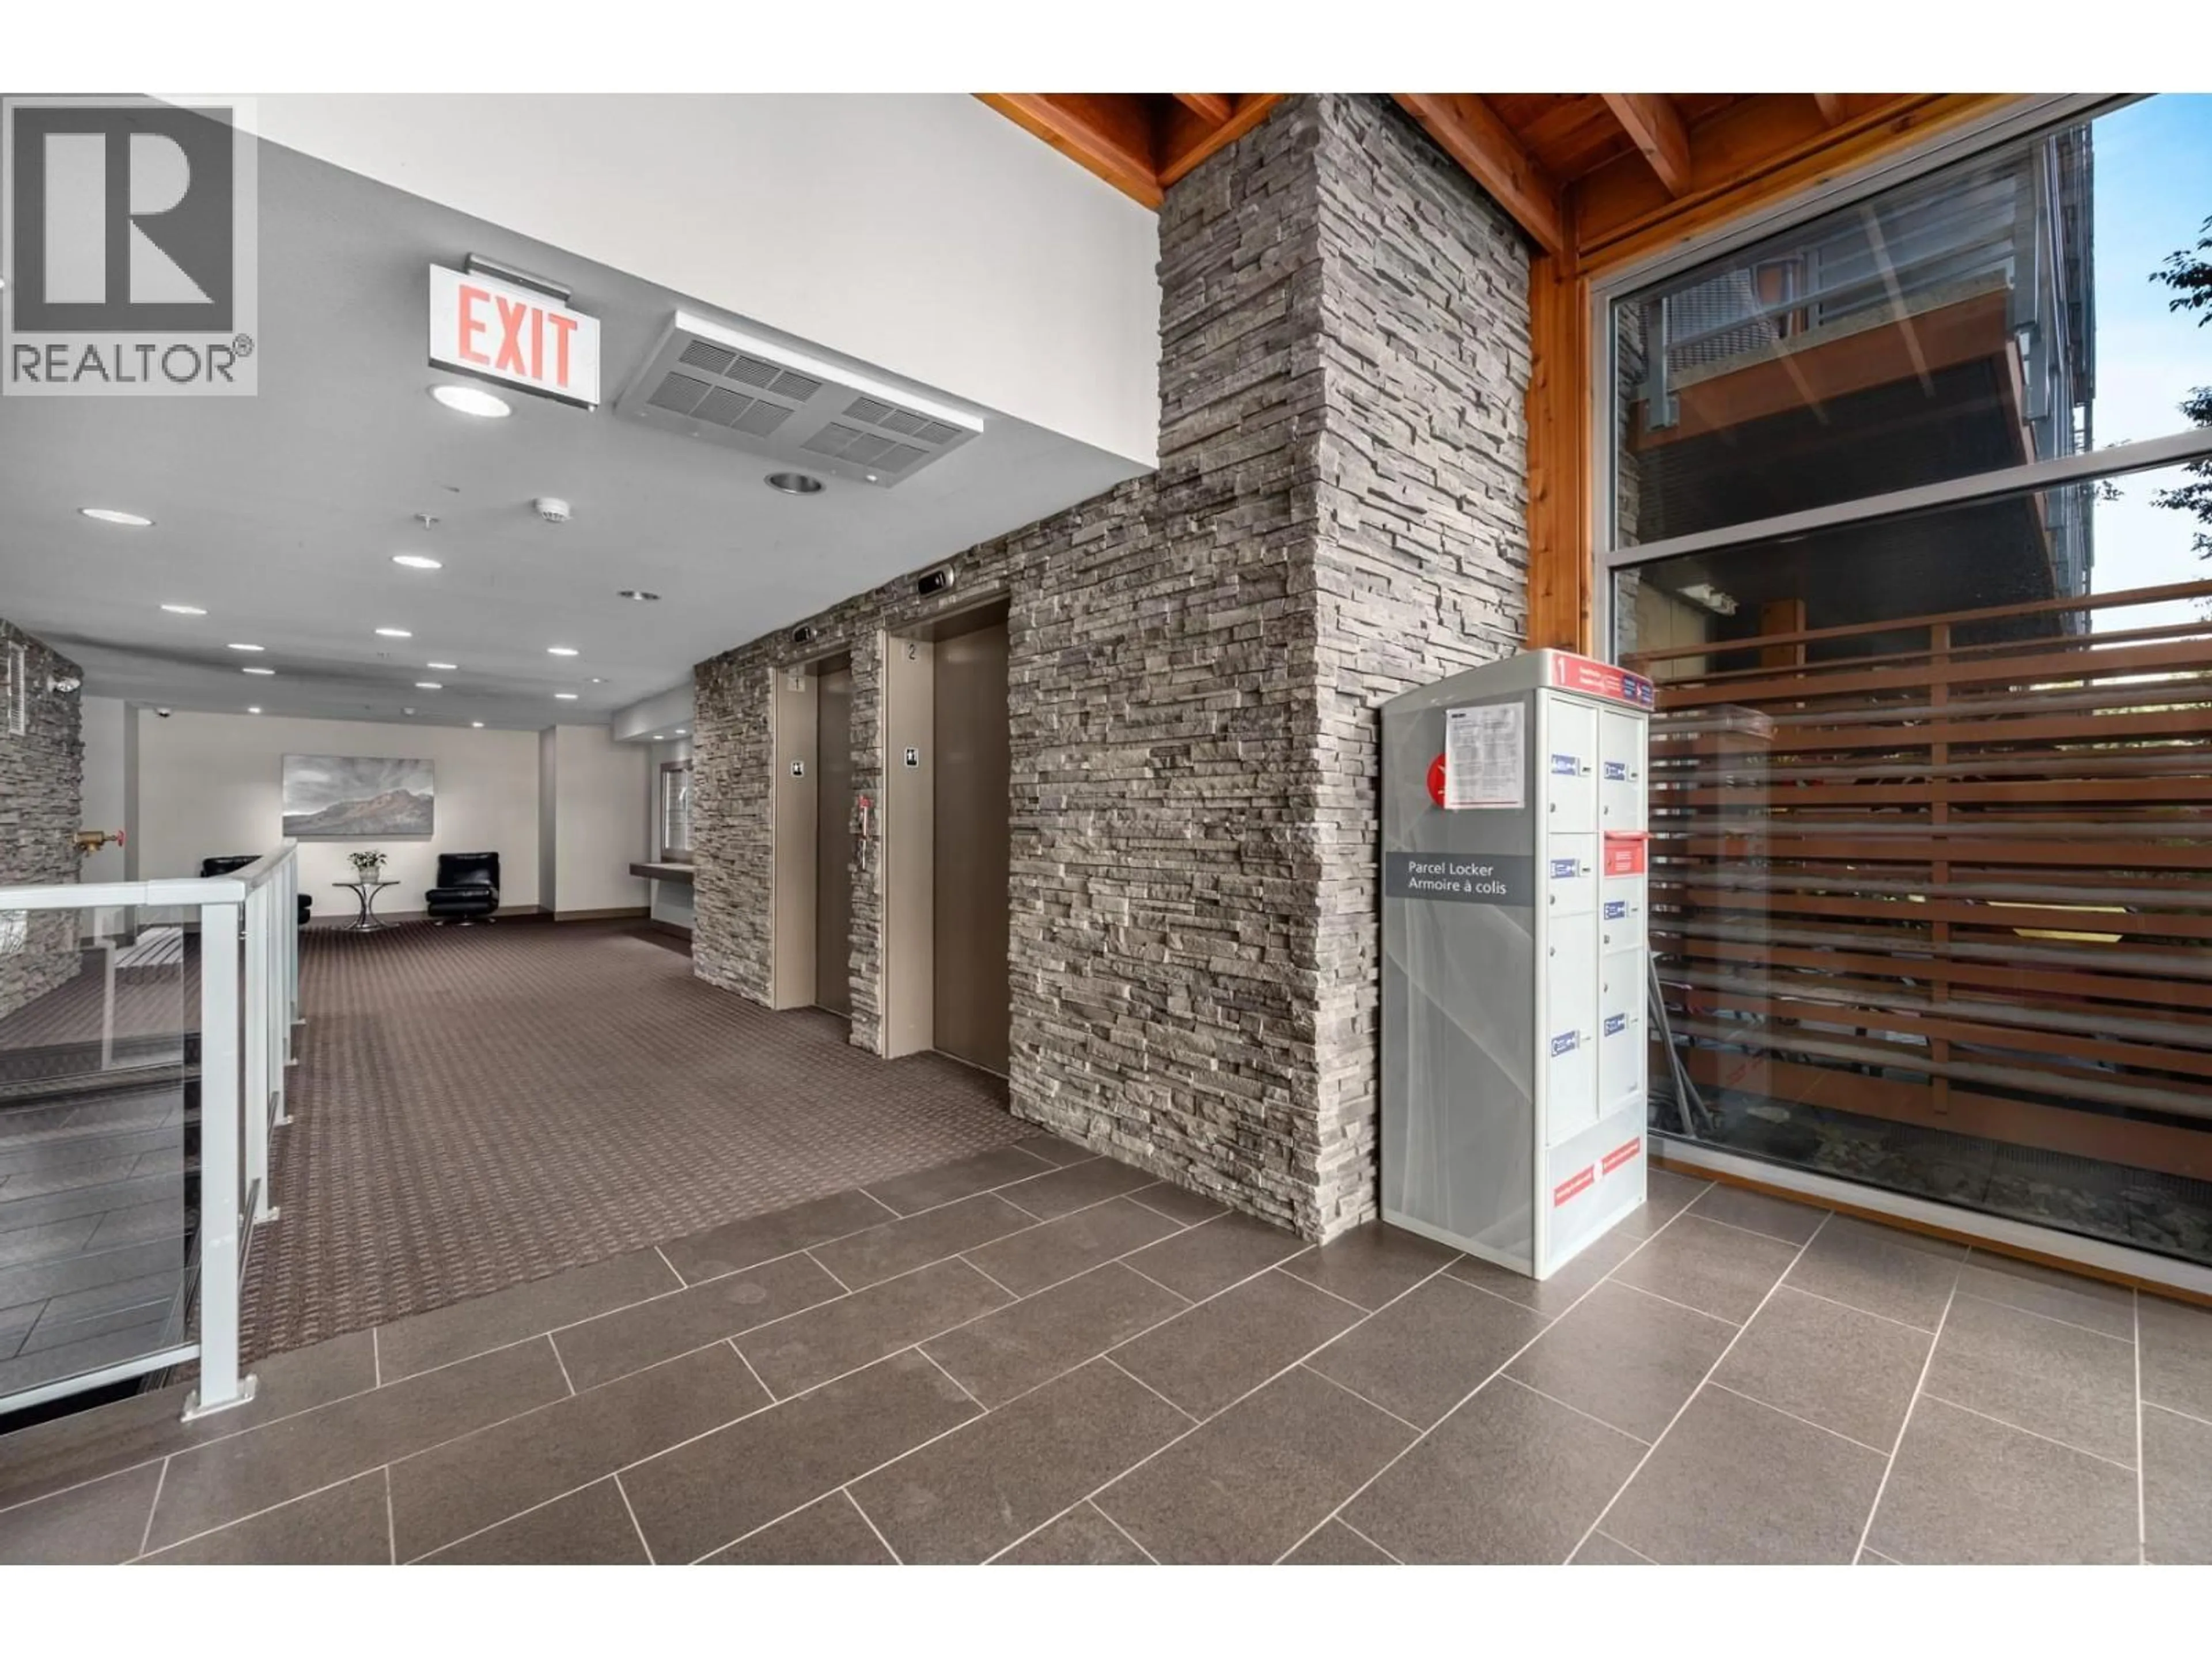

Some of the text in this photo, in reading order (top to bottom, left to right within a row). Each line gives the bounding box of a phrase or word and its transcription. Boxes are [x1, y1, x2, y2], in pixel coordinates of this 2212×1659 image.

[459, 284, 578, 389] EXIT
[908, 643, 916, 661] 2
[1558, 656, 1566, 685] 1
[1408, 861, 1494, 877] Parcel Locker
[1408, 876, 1507, 895] Armoire à colis
